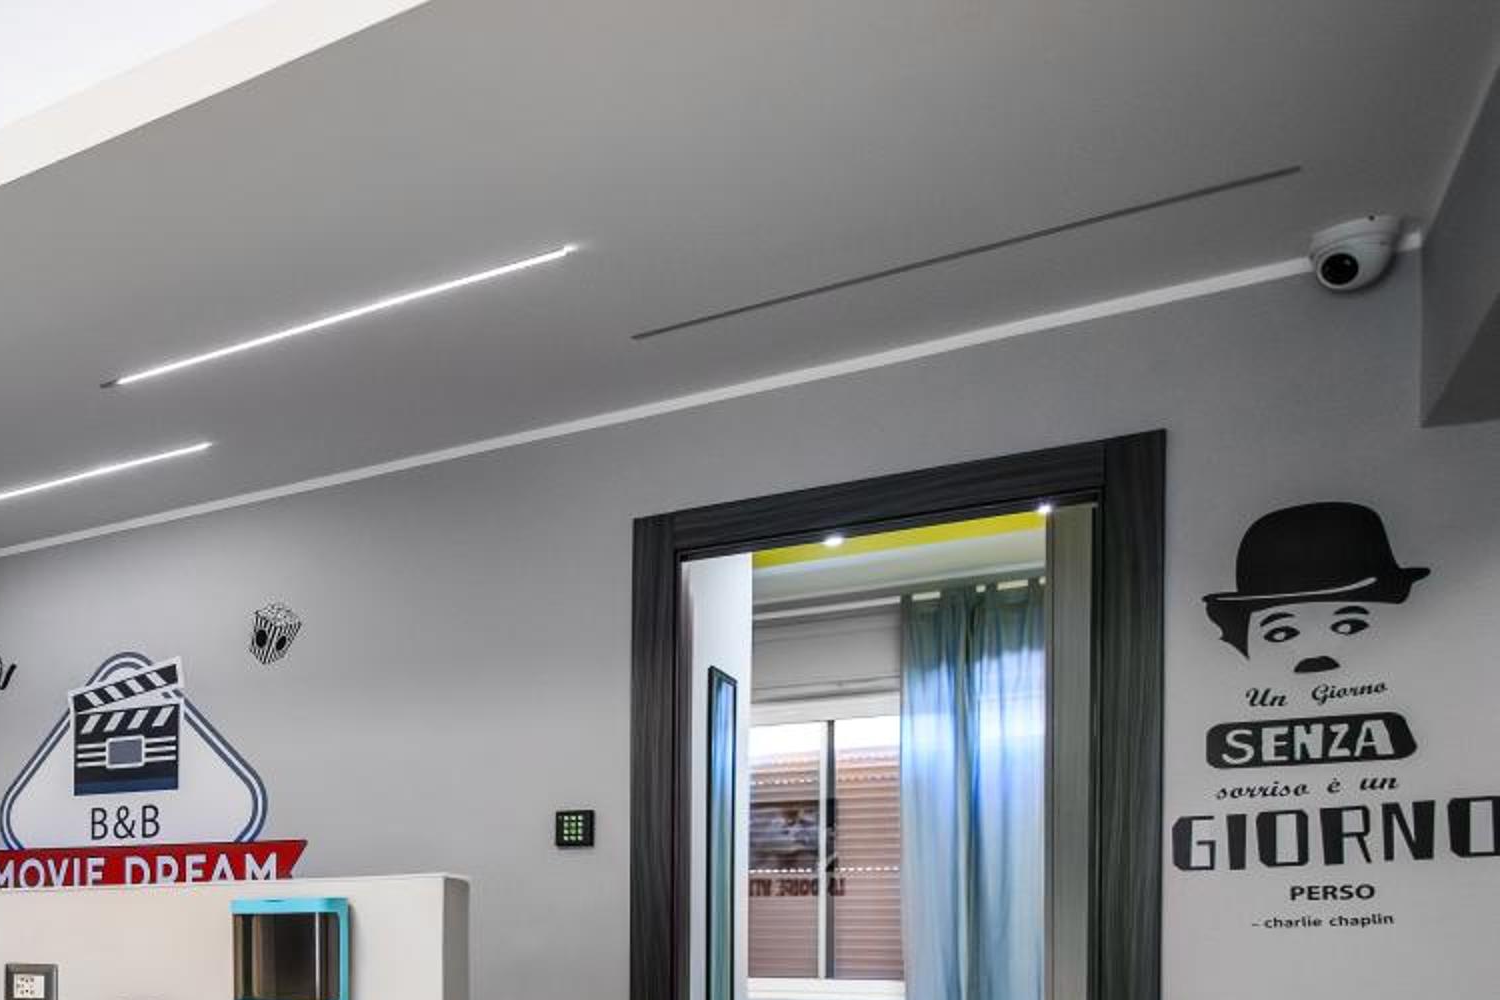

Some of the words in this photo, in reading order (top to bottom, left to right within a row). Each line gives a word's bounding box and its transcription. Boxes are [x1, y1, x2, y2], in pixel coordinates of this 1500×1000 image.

[1246, 687, 1288, 707] Un
[1311, 682, 1388, 706] Giorno
[1221, 718, 1395, 765] SENZA
[1216, 780, 1310, 801] sorriso
[1359, 776, 1398, 791] un
[90, 804, 161, 841] B&B
[1171, 796, 1500, 872] GIORNO
[125, 852, 277, 886] DREAM
[1290, 883, 1376, 901] PERSO
[1264, 915, 1323, 929] charlie
[1329, 912, 1395, 930] chaplin
